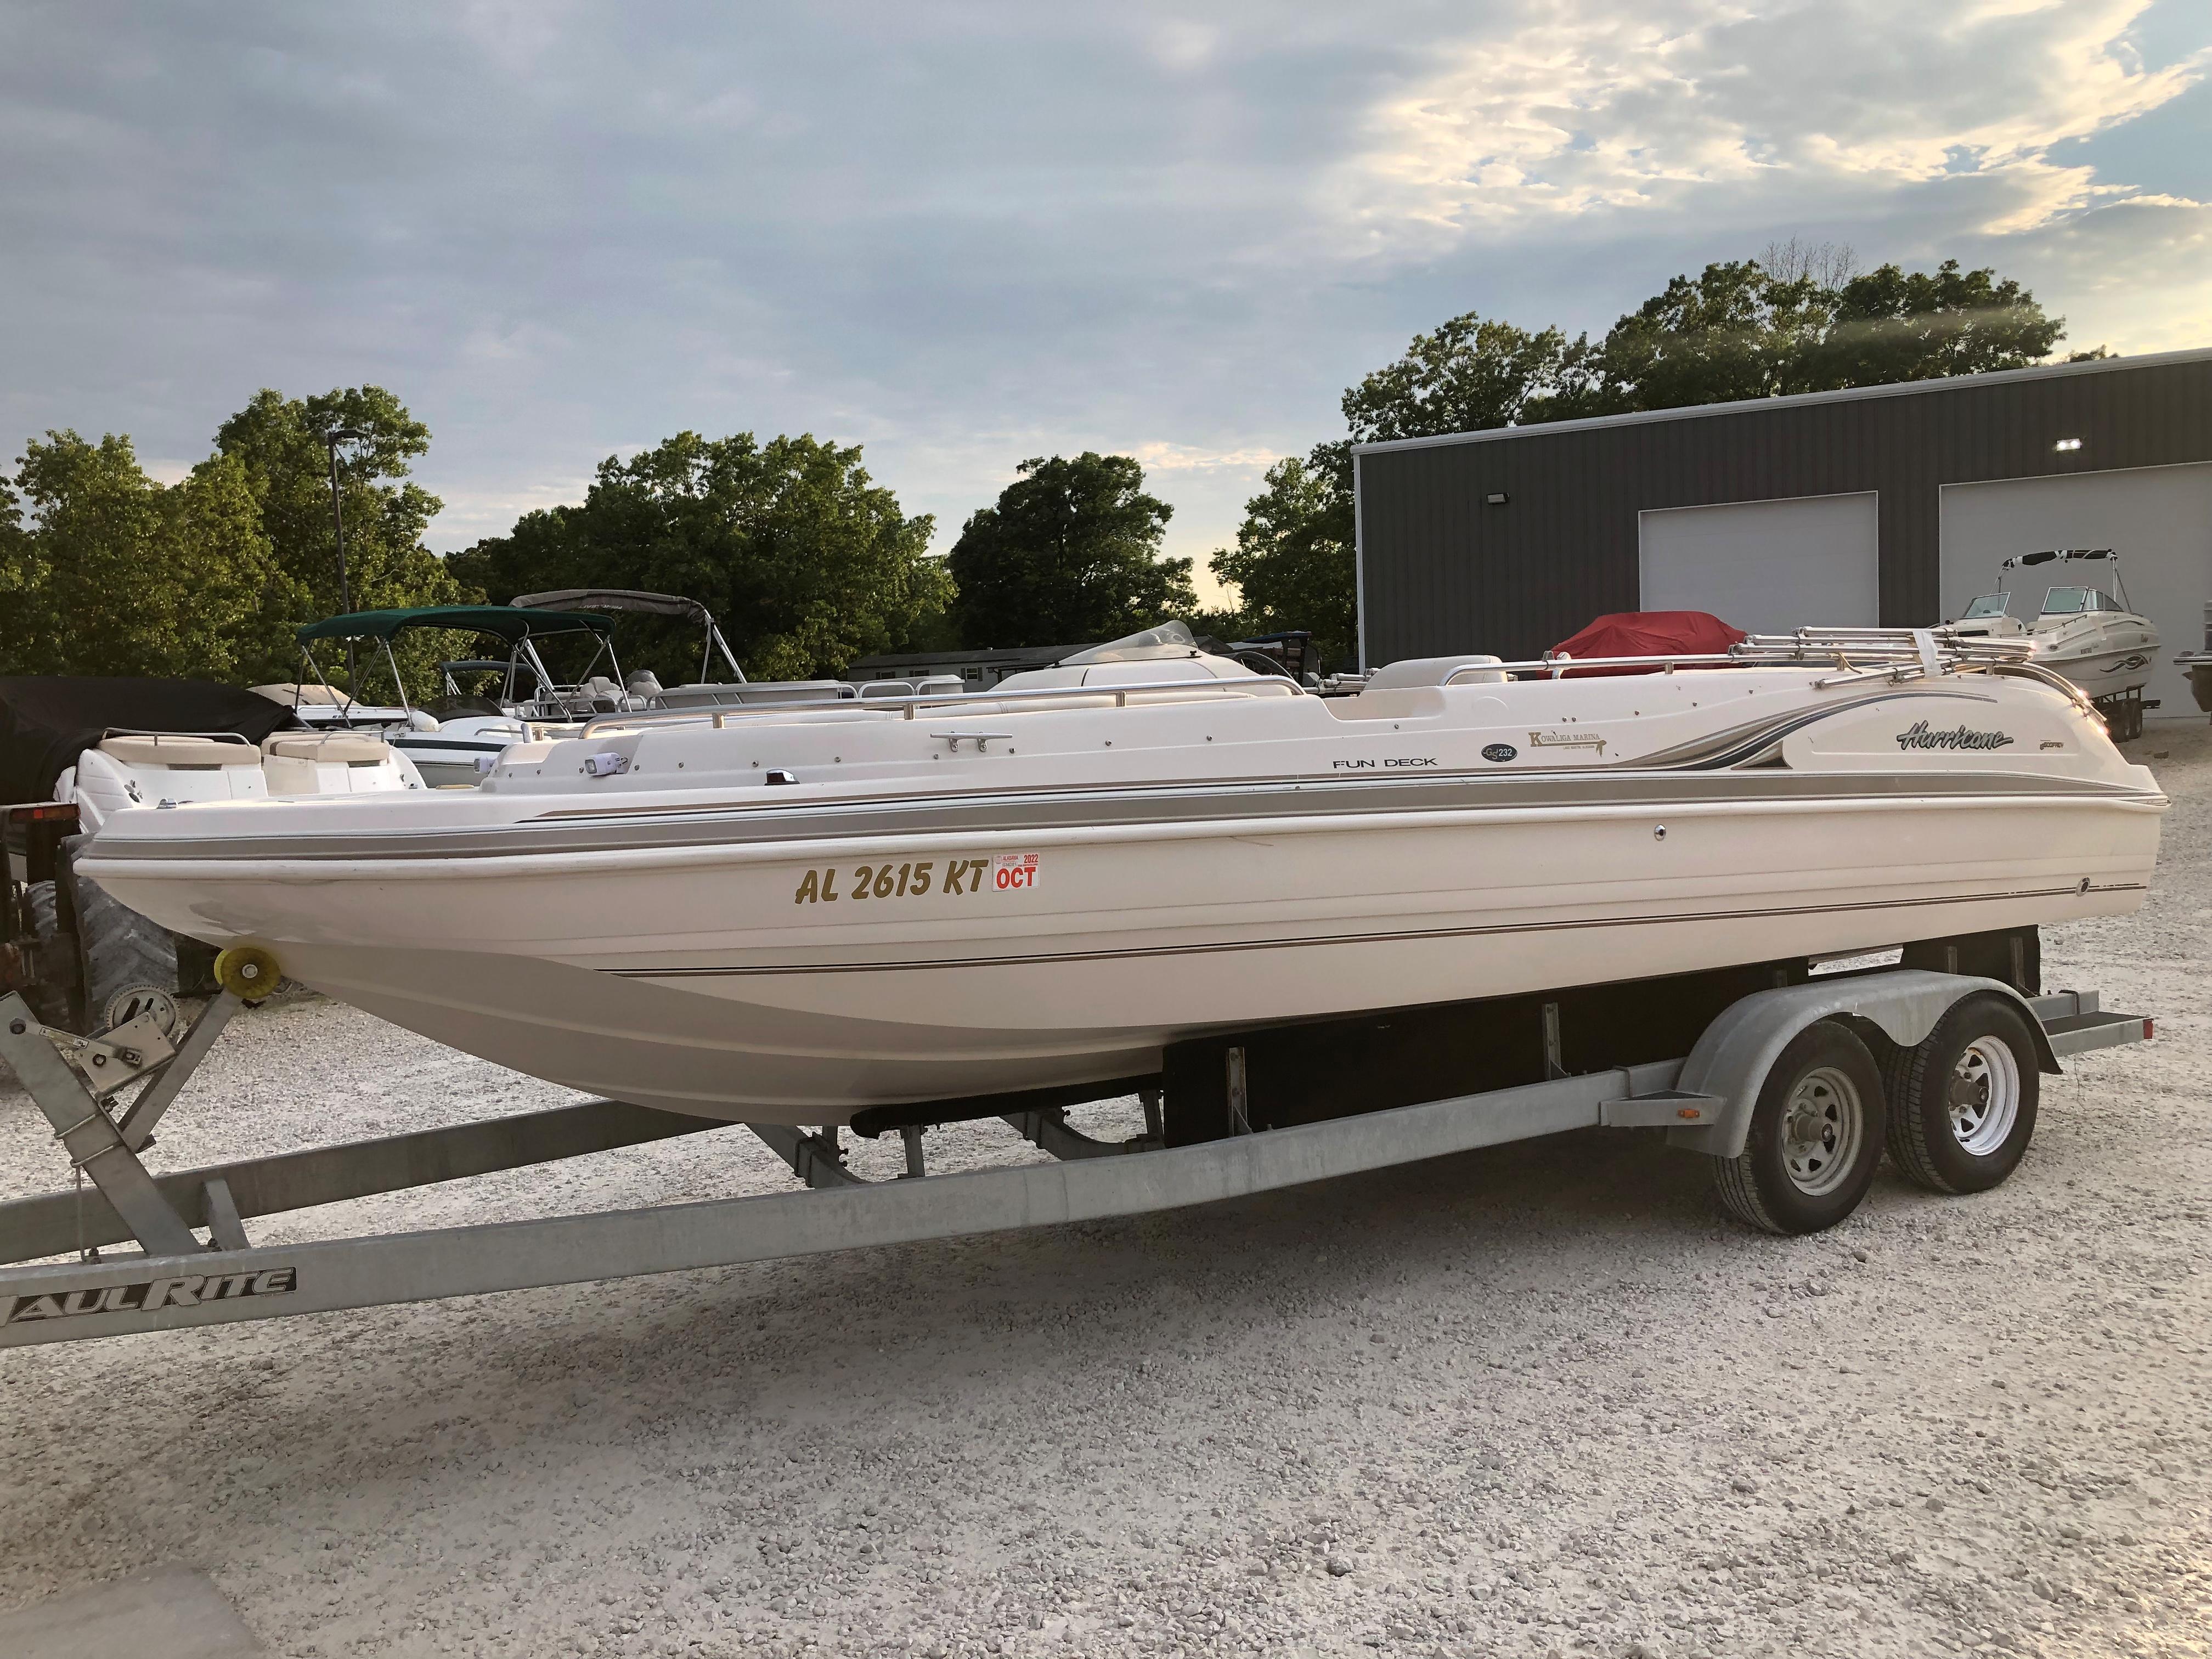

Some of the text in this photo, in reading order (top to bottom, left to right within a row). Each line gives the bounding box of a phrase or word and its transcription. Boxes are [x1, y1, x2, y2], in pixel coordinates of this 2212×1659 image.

[1528, 732, 1571, 747] KOWALIGA
[1897, 720, 2013, 750] Hurricane
[1498, 748, 1512, 757] 232
[1333, 758, 1438, 769] FUN DECK
[1024, 854, 1039, 863] 2022
[795, 859, 989, 904] AL 2615 KT
[996, 867, 1036, 889] OCT
